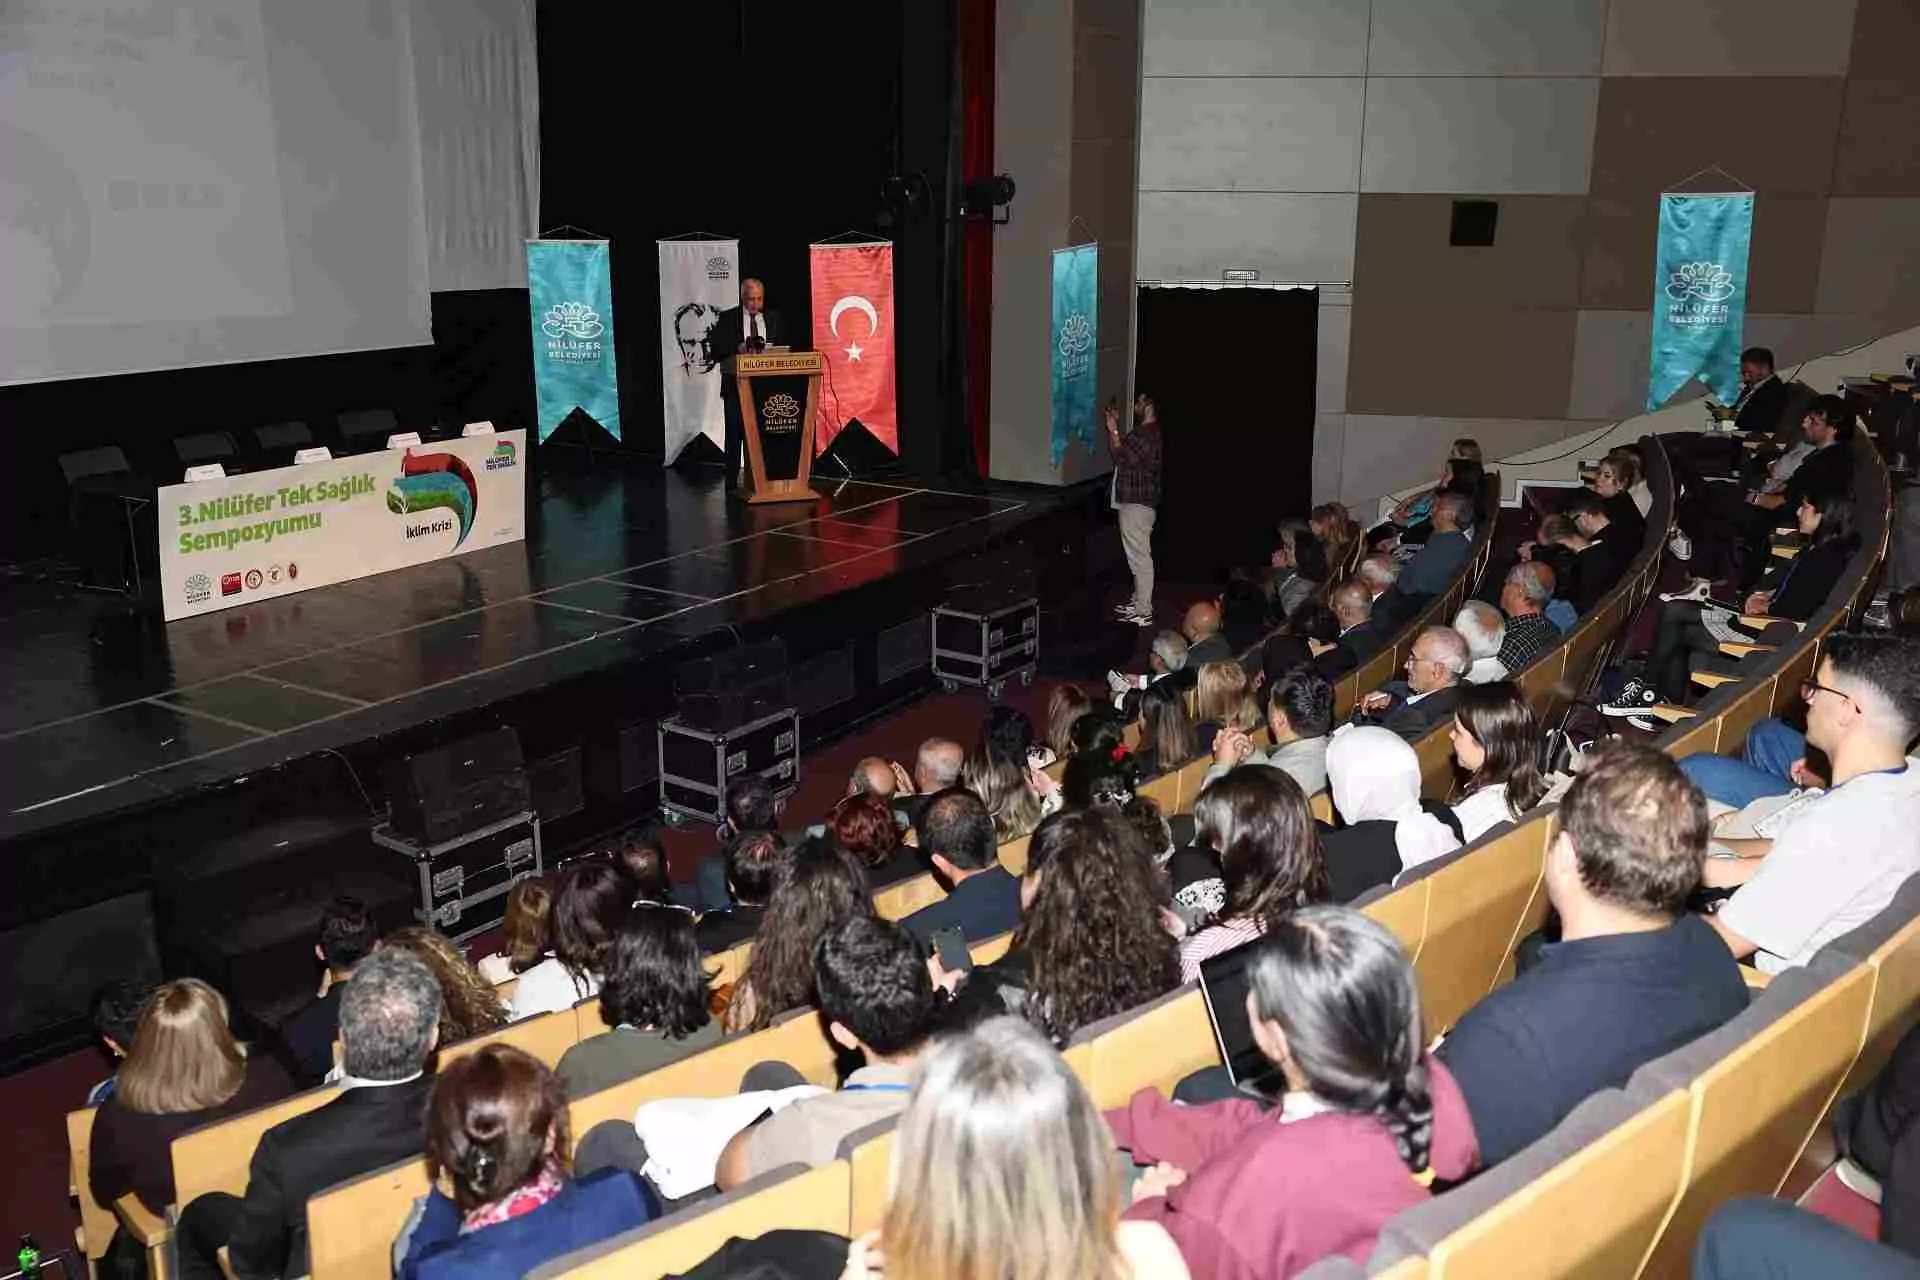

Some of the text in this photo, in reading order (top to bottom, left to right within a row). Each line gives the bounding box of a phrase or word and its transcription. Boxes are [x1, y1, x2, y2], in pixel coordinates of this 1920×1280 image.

[278, 483, 314, 508] Tek
[316, 474, 376, 502] Sağlık
[179, 512, 322, 554] Sempozyumu
[406, 519, 452, 539] İklim Krizi
